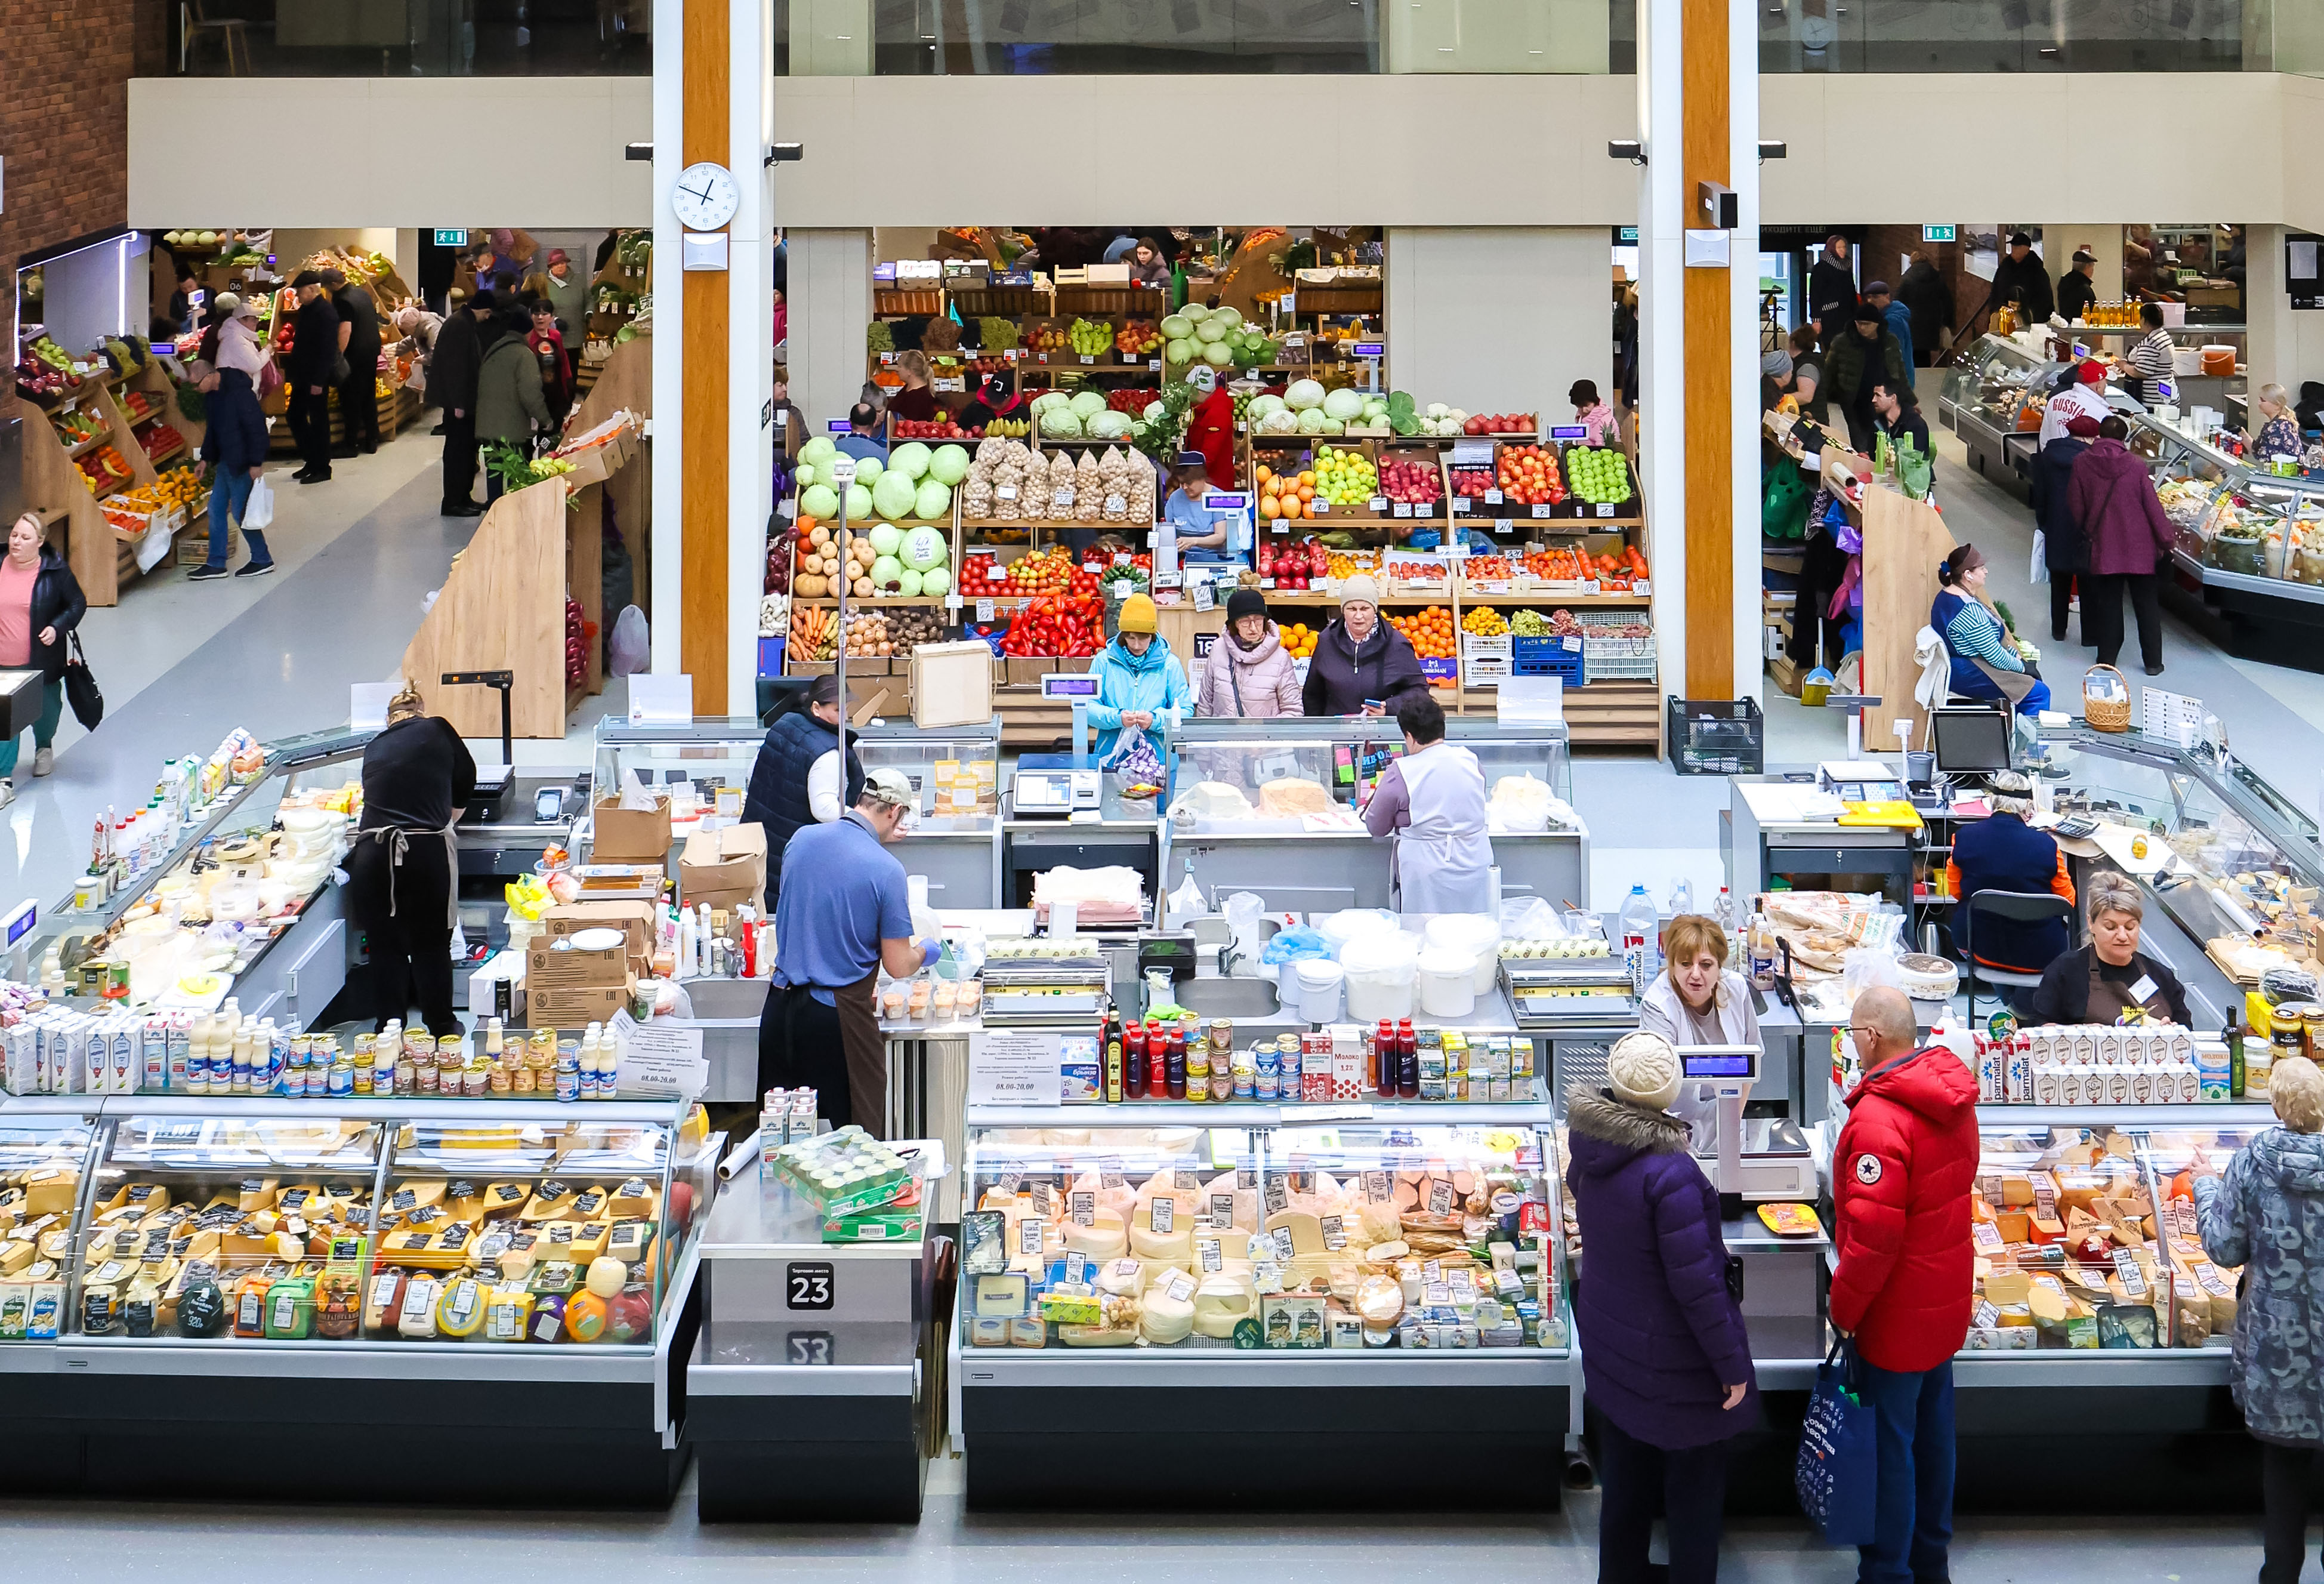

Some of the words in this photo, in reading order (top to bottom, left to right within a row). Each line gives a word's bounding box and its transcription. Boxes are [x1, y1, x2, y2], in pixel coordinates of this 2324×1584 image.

[2053, 397, 2086, 418] RUSSIA
[1198, 641, 1214, 655] 18
[641, 1075, 677, 1083] 08.00-20.00
[1994, 1056, 2003, 1101] parmalat
[2024, 1057, 2032, 1101] parmalat
[792, 1277, 829, 1303] 23
